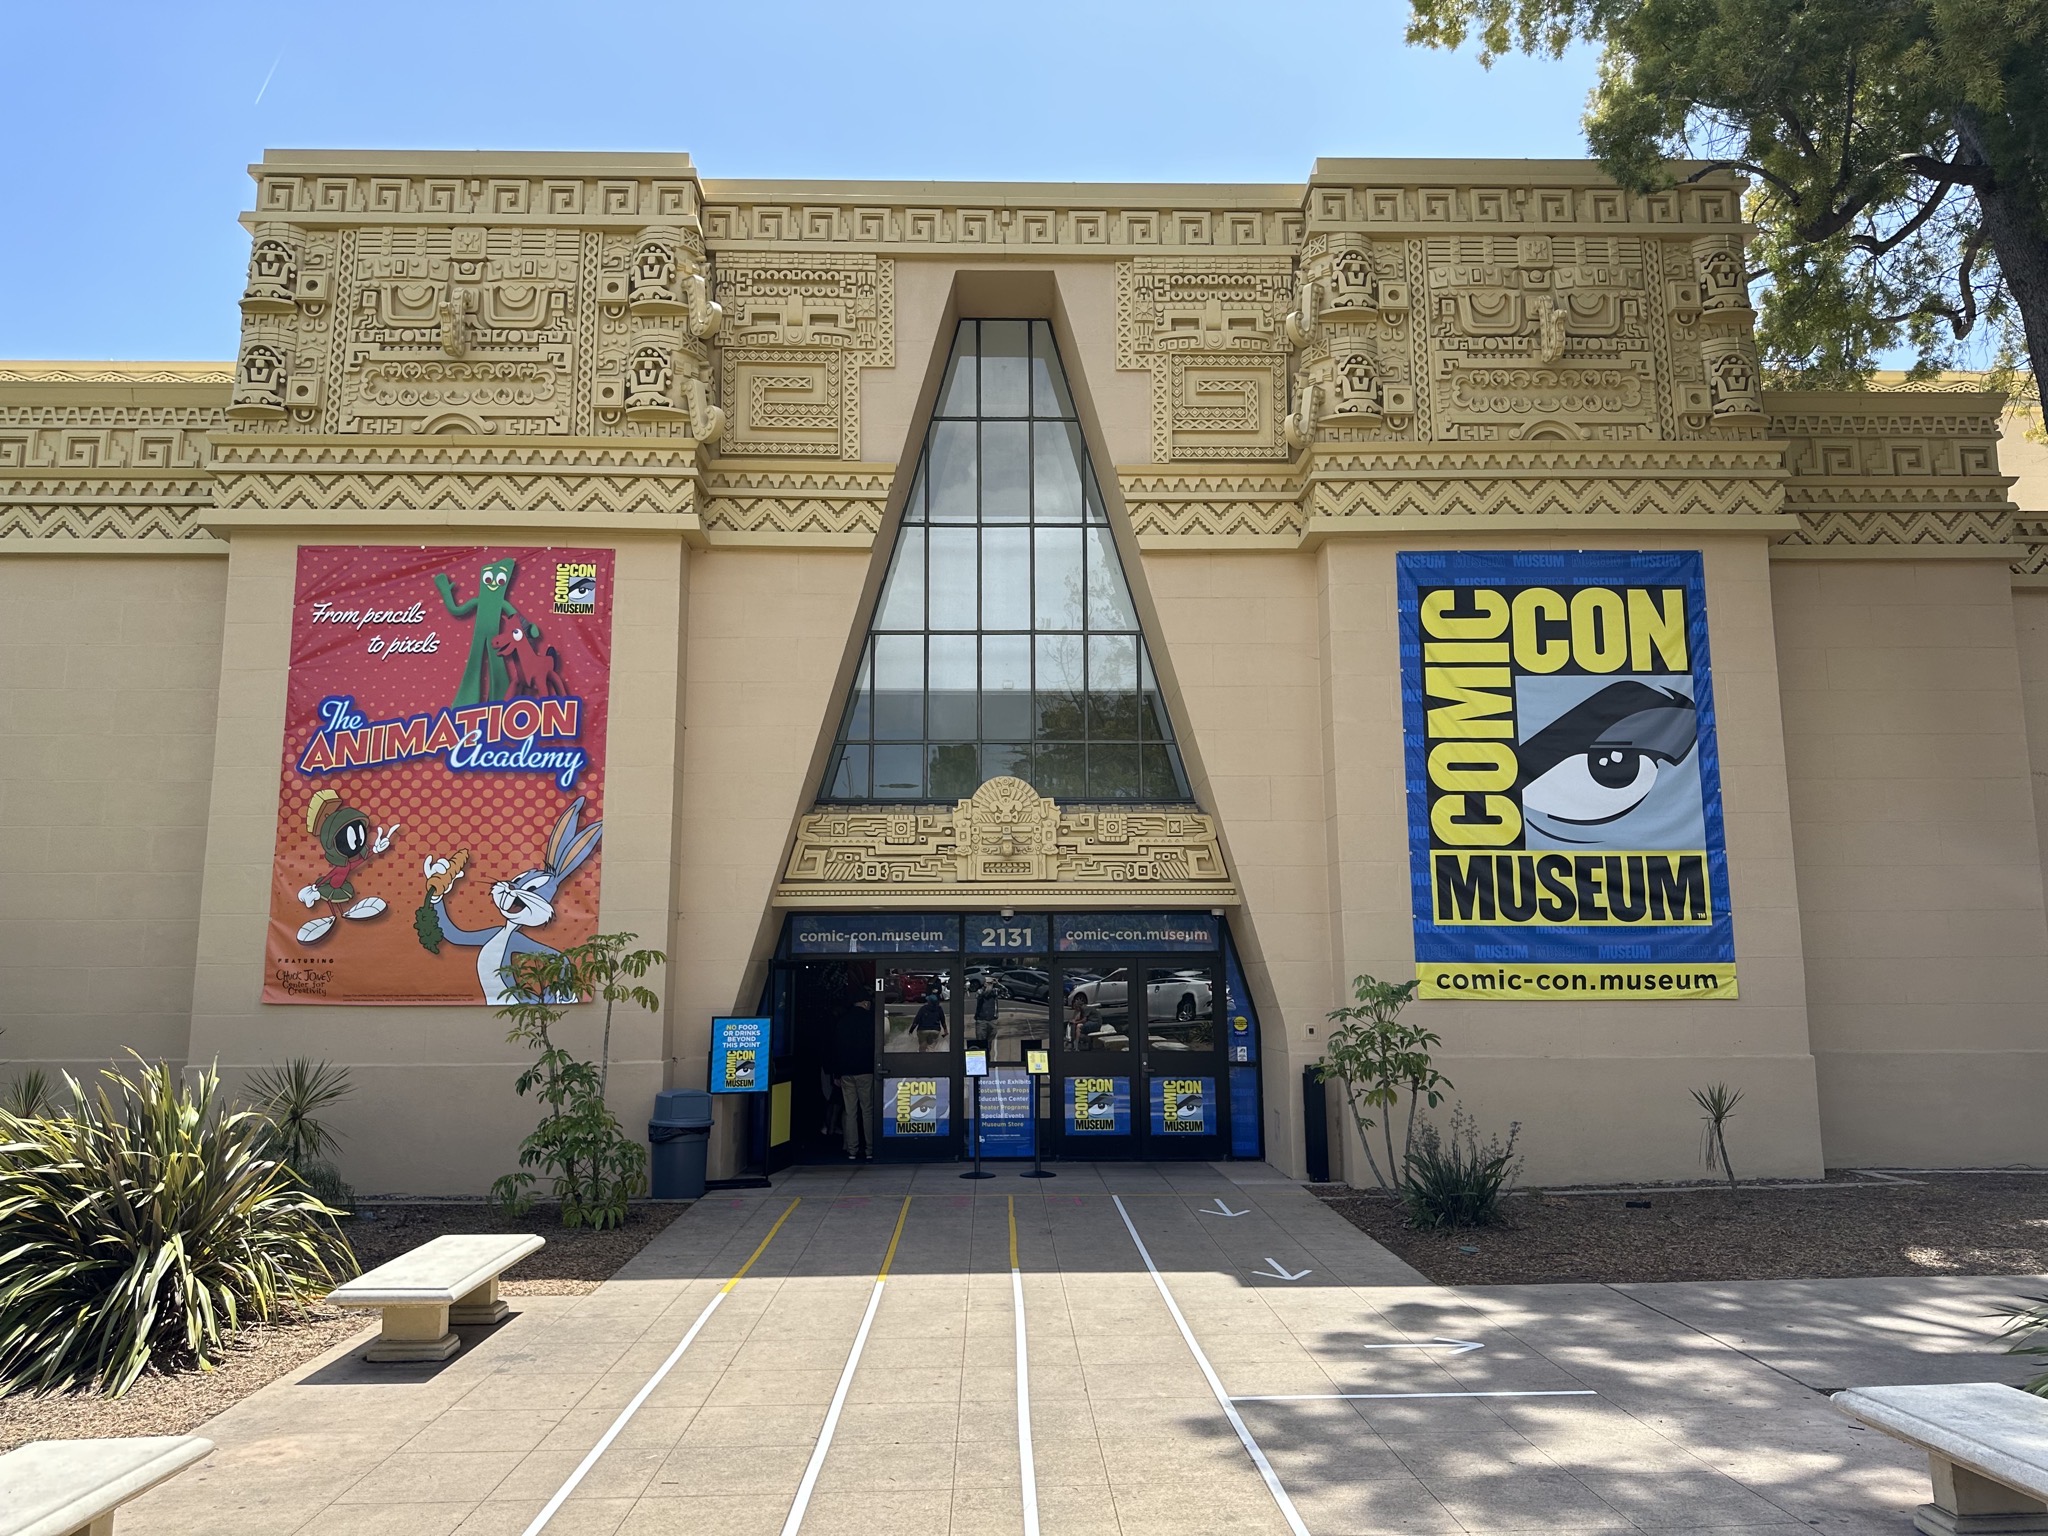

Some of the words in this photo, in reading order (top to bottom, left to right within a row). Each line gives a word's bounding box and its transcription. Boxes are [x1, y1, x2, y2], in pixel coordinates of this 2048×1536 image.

[1513, 554, 1564, 567] MUSEUM
[1631, 555, 1681, 567] MUSEUM
[569, 563, 597, 577] CON
[554, 563, 570, 603] COMIC
[554, 603, 594, 613] MUSEUM
[312, 602, 360, 624] From
[356, 602, 426, 631] pencils
[1511, 587, 1689, 674] CON
[367, 634, 385, 654] to
[381, 631, 440, 661] pixels
[322, 700, 363, 733] The
[1420, 589, 1522, 847] COMIC
[301, 700, 578, 772] ANIMATION
[450, 729, 584, 787] Academy
[1434, 854, 1708, 922] MUSEUM
[799, 929, 943, 942] comic-con.museum
[981, 927, 1032, 947] 2131
[1065, 928, 1208, 941] comic-con.museum
[1474, 945, 1529, 959] MUSEUM
[1598, 945, 1651, 959] MUSEUM
[282, 980, 309, 989] Center
[876, 979, 882, 991] 1
[1436, 968, 1719, 991] comic-con.museum
[288, 986, 327, 997] Creativity
[736, 1050, 755, 1060] CON
[726, 1050, 737, 1080] COMIC
[725, 1079, 754, 1087] MUSEUM
[910, 1081, 936, 1095] CON
[1088, 1078, 1113, 1092] CON
[1176, 1080, 1202, 1094] CON
[897, 1081, 911, 1122] COMIC
[1074, 1078, 1089, 1119] COMIC
[1163, 1080, 1178, 1121] COMIC
[897, 1122, 936, 1133] MUSEUM
[1075, 1119, 1114, 1130] MUSEUM
[1164, 1121, 1203, 1132] MUSEUM
